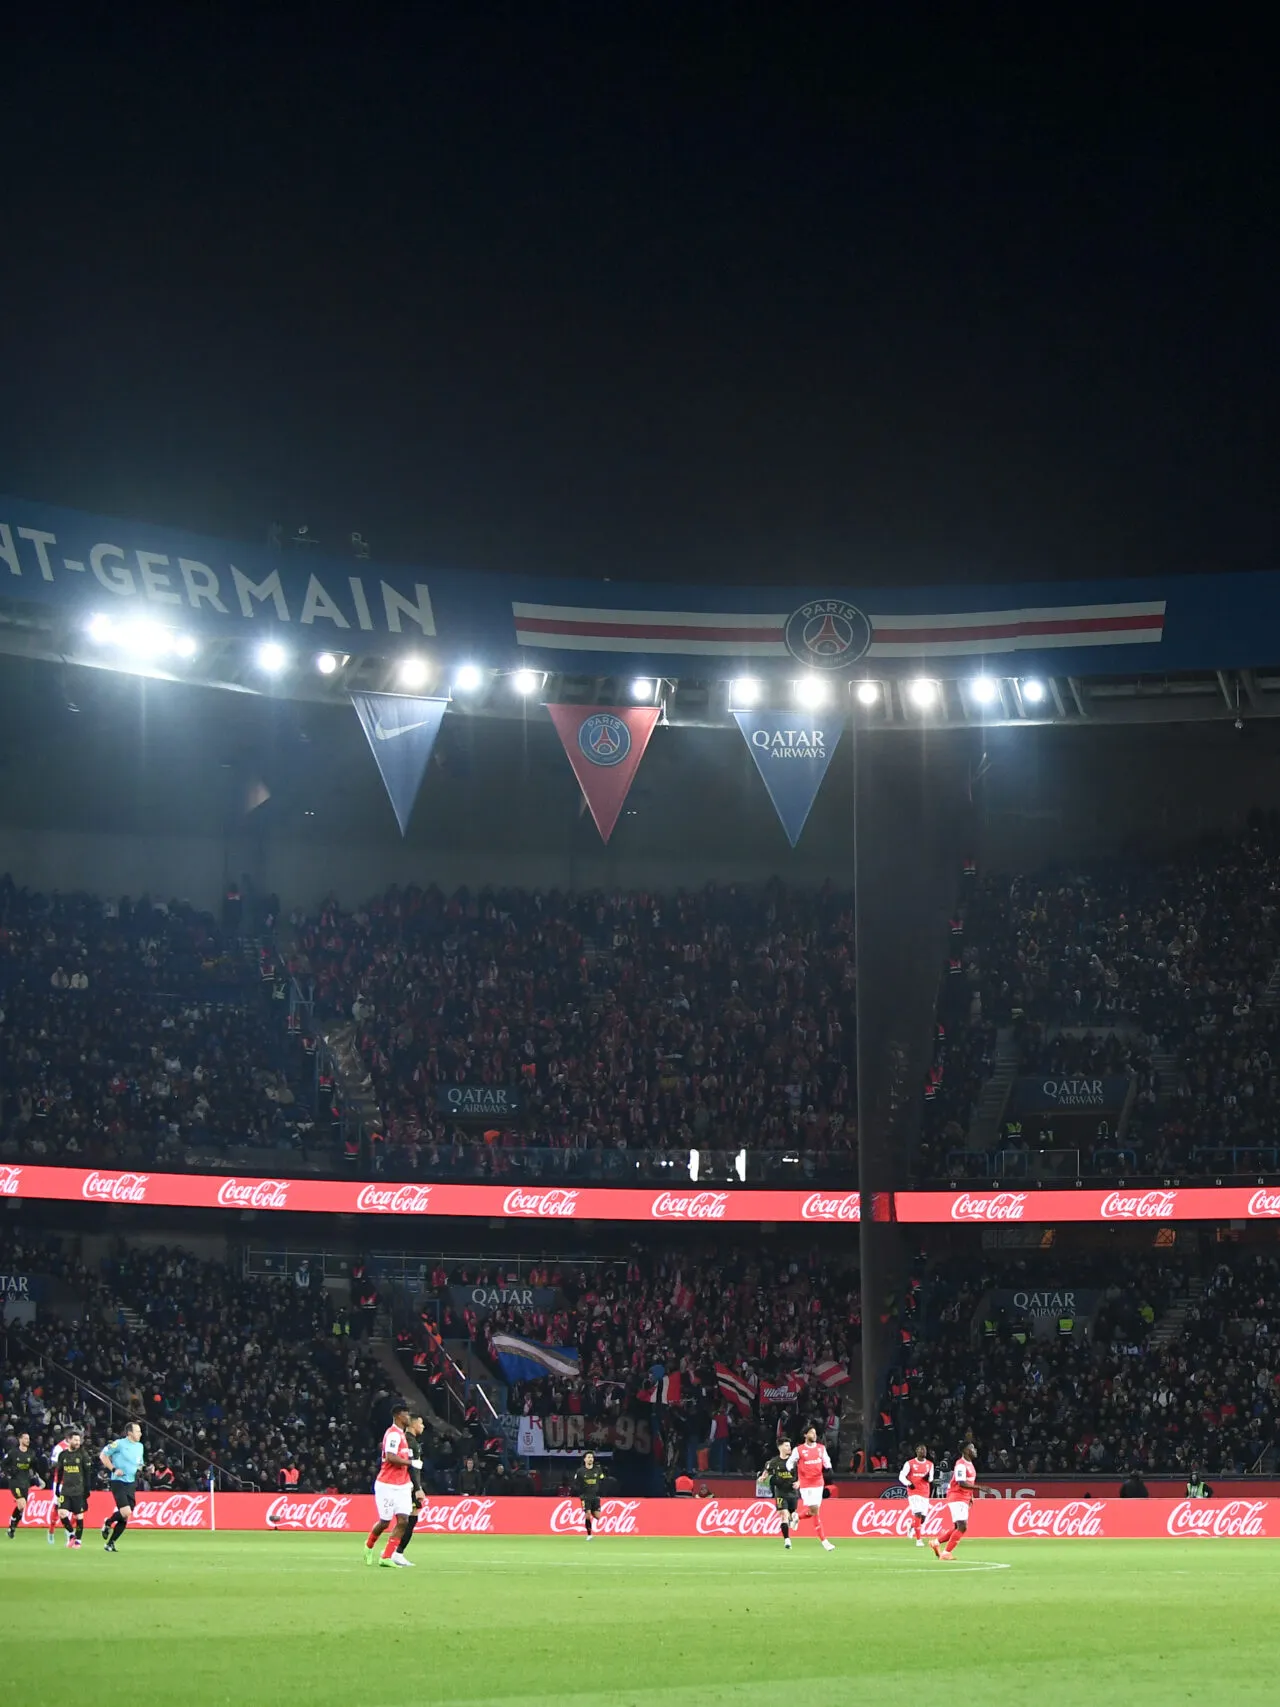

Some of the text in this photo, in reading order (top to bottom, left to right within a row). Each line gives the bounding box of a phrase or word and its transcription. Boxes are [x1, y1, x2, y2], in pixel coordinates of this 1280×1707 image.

[802, 603, 857, 620] PARIS
[587, 716, 621, 730] PARIS
[752, 730, 825, 750] QATAR
[771, 747, 826, 758] AIRWAYS
[447, 1088, 507, 1105] QATAR
[1043, 1080, 1103, 1097] QATAR
[1058, 1095, 1104, 1105] AIRWAYS
[463, 1103, 508, 1114] AIRWAYS
[82, 1172, 150, 1201] Coca-Cola
[217, 1179, 290, 1208] Coca-Cola
[357, 1185, 432, 1212] Coca-Cola
[503, 1189, 579, 1216] Coca-Cola
[652, 1192, 730, 1218] Coca-Cola
[951, 1193, 1028, 1219] Coca-Cola
[1100, 1192, 1178, 1218] Coca-Cola
[472, 1288, 534, 1306] QATAR
[1013, 1292, 1077, 1310] QATAR
[266, 1496, 352, 1529] Coca-Cola
[1008, 1501, 1106, 1536] Coca-Cola
[1167, 1501, 1268, 1536] Coca-Cola
